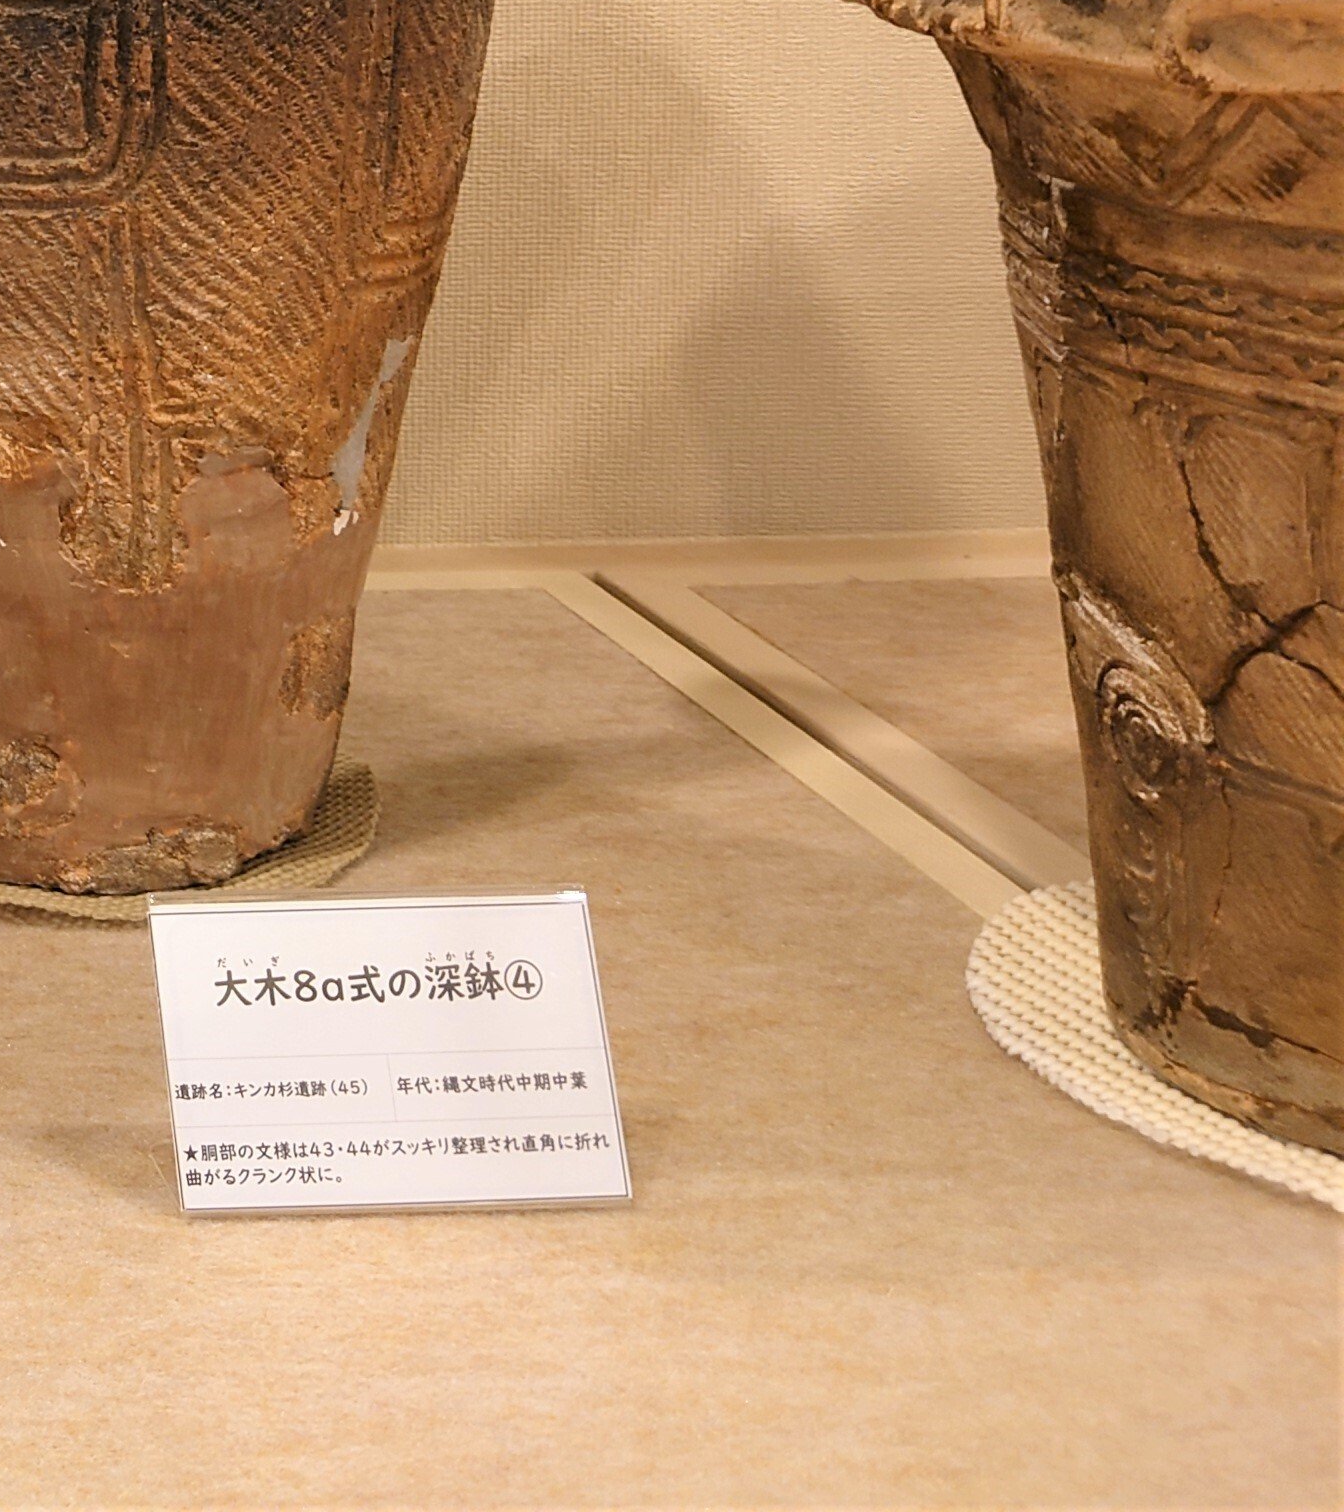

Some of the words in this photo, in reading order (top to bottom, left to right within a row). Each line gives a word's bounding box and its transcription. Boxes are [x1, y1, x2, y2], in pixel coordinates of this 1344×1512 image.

[214, 960, 544, 1007] 大木8a式の深鉢④
[396, 1071, 588, 1095] 年代：縄文時代中期中葉
[185, 1165, 344, 1187] 曲がるクランク状に。
